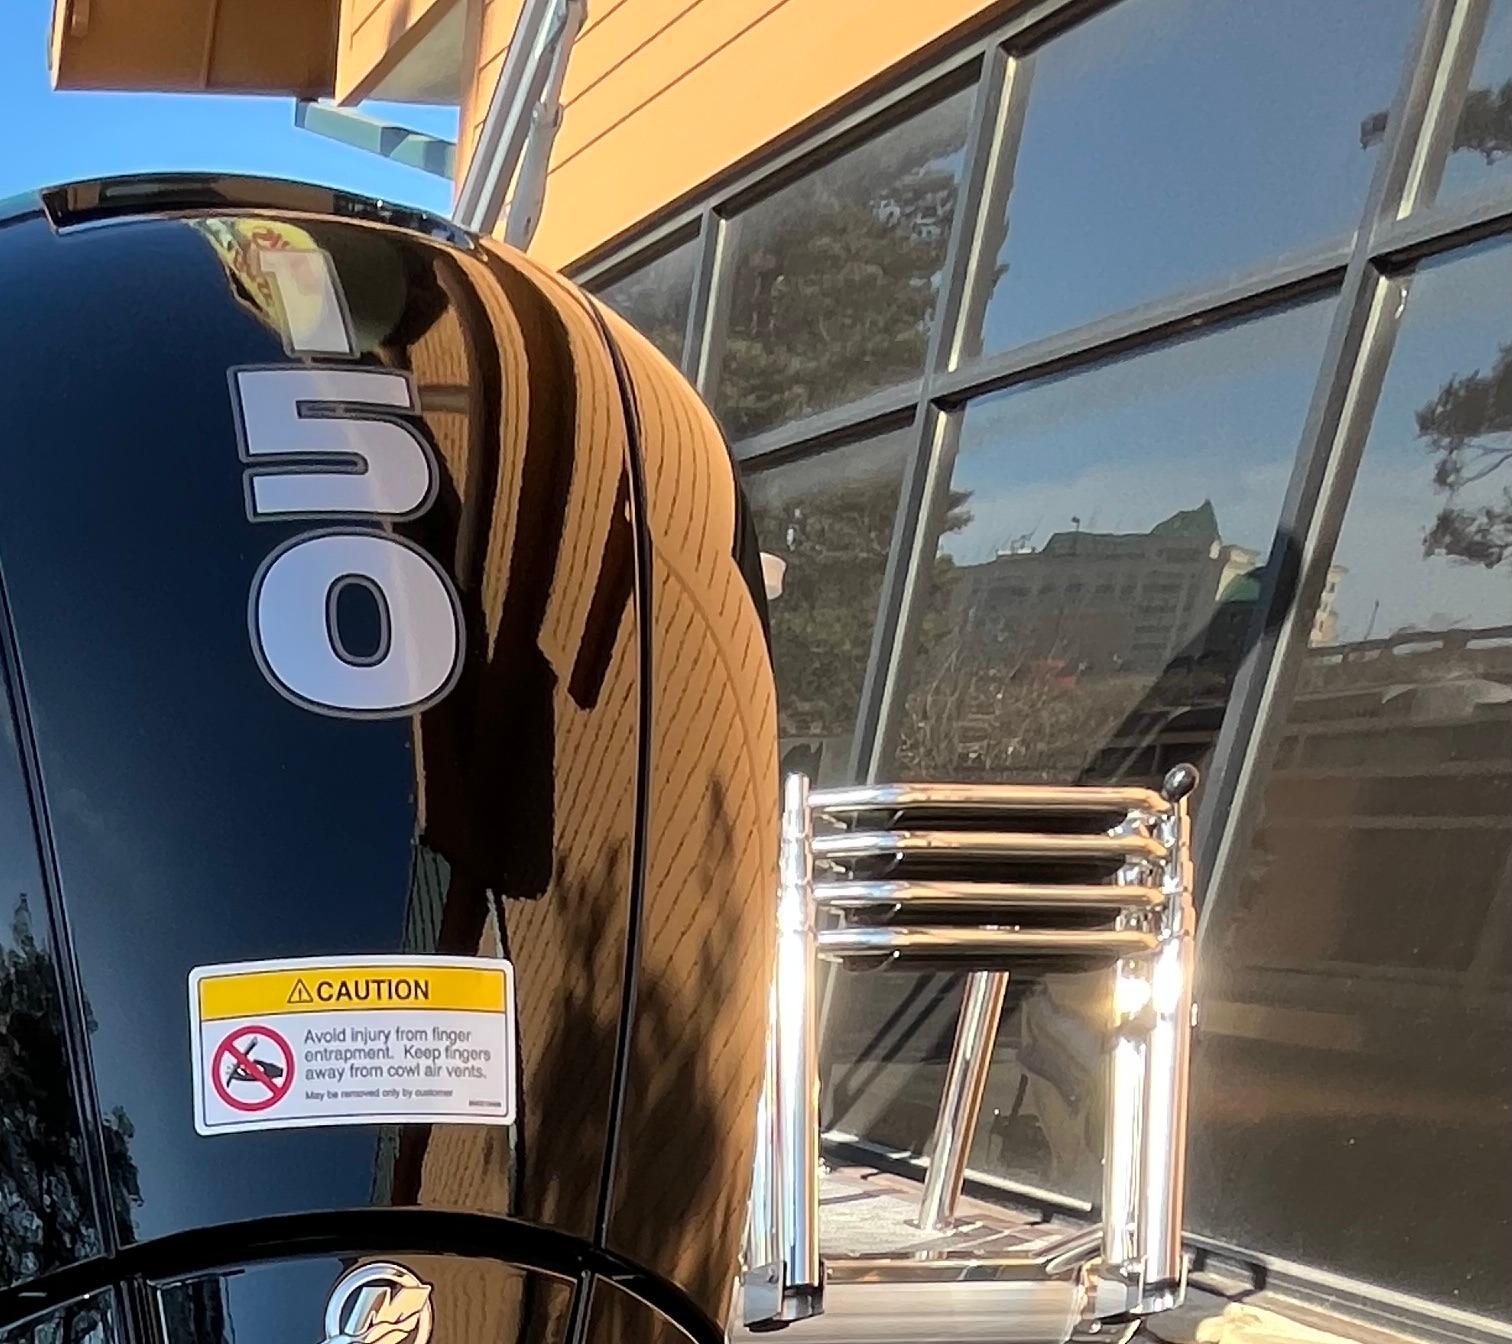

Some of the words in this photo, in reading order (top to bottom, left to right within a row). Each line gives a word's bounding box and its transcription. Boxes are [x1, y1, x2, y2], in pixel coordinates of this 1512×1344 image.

[226, 246, 466, 720] 150
[316, 979, 430, 1002] CAUTION
[304, 1027, 346, 1044] Avoid
[351, 1027, 391, 1045] injury
[396, 1026, 428, 1042] from
[432, 1026, 471, 1046] finger
[304, 1046, 394, 1063] entrapment.
[404, 1045, 442, 1064] Keep
[445, 1045, 491, 1064] fingers
[305, 1066, 345, 1083] away
[350, 1062, 383, 1079] from
[387, 1063, 420, 1077] cowl
[424, 1063, 441, 1077] air
[446, 1064, 487, 1080] vents.
[305, 1090, 325, 1102] May
[327, 1089, 339, 1099] be
[340, 1088, 380, 1099] removed
[382, 1088, 401, 1100] only
[402, 1087, 413, 1099] by
[414, 1088, 453, 1098] customer
